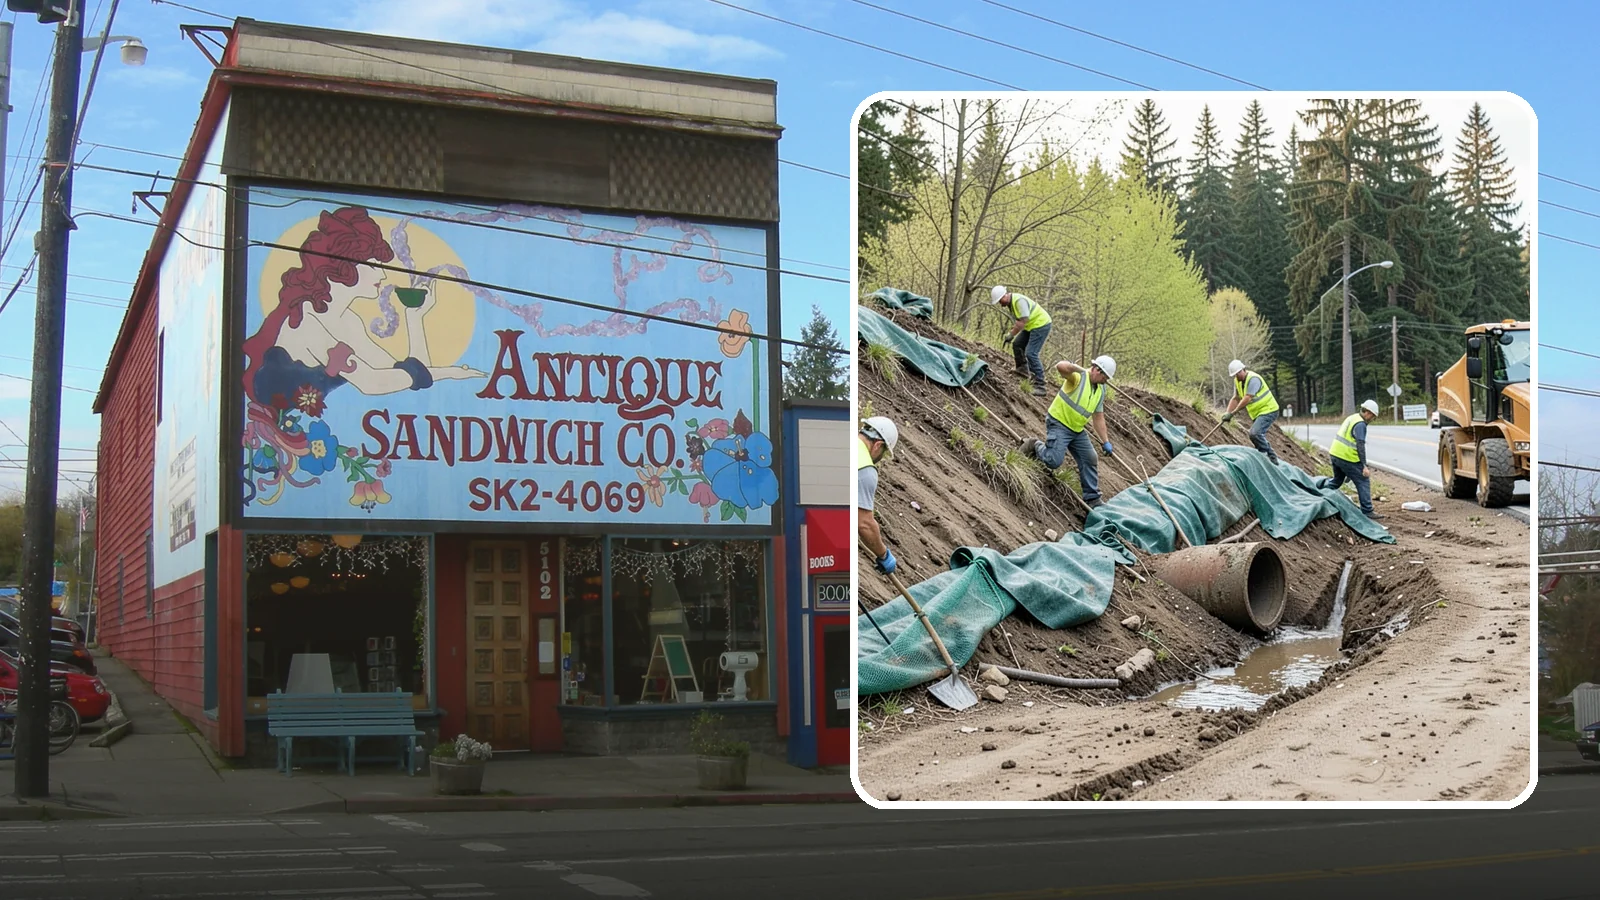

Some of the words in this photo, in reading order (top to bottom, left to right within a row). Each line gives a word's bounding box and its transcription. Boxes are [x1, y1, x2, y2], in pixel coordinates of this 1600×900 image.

[476, 330, 723, 421] ANTIQUE
[361, 408, 605, 467] SANDWICH
[617, 422, 685, 469] CO.
[468, 478, 645, 513] SK2-4069
[539, 541, 552, 600] 5102
[809, 555, 835, 569] BOOKS
